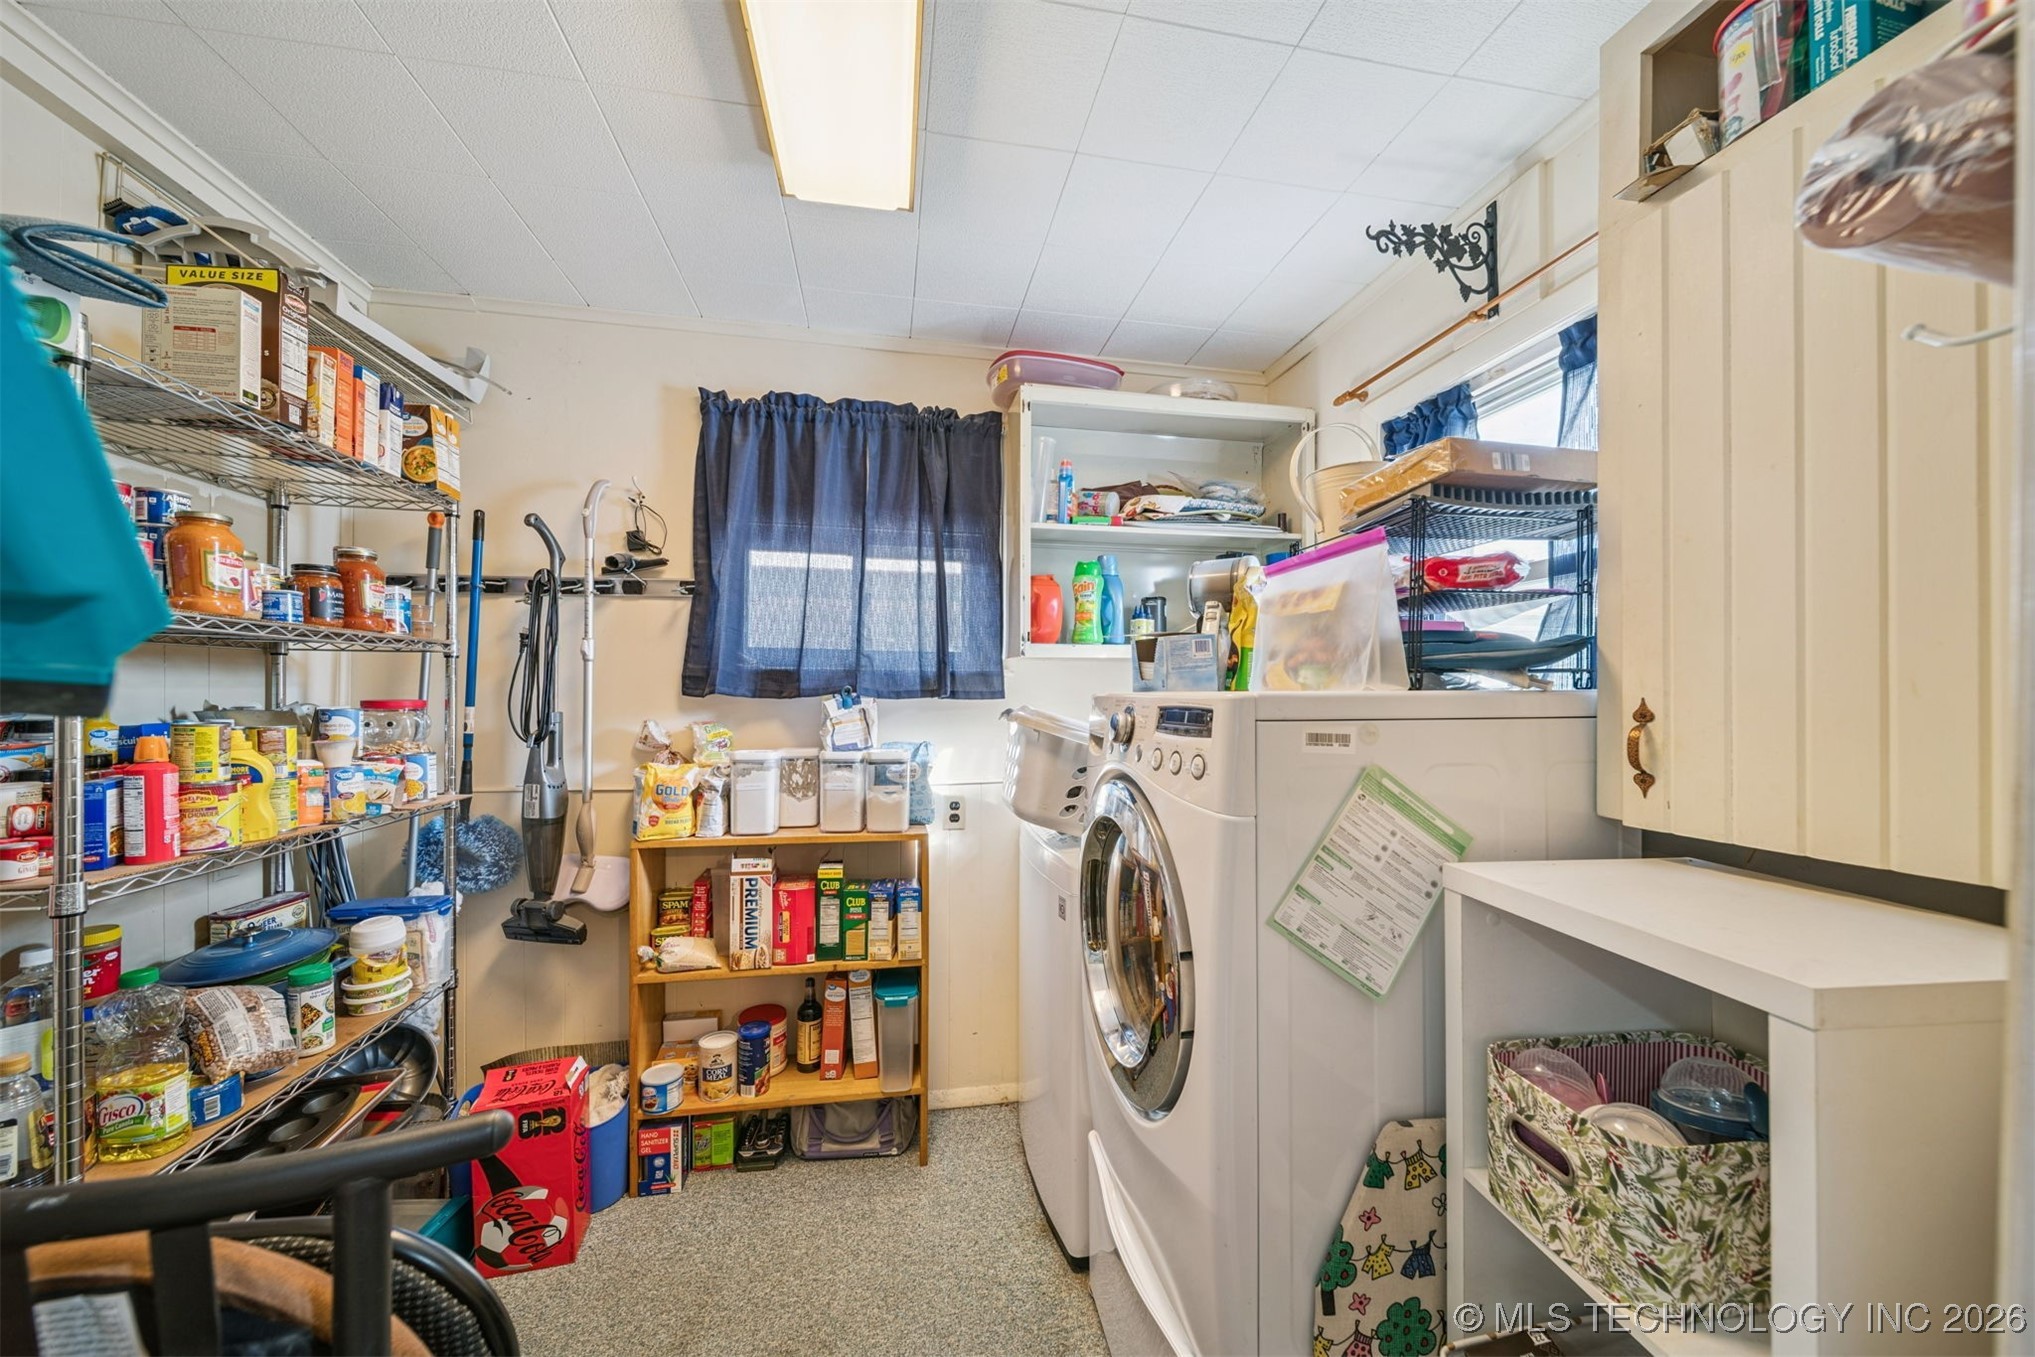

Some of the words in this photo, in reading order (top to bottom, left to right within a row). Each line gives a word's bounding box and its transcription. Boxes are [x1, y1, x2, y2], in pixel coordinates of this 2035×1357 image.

[179, 269, 226, 280] VALUE
[231, 271, 264, 281] SIZE
[1072, 580, 1095, 596] Gain
[656, 784, 689, 796] GOLD
[820, 880, 840, 890] CLUB
[662, 900, 689, 910] SPAM
[846, 897, 866, 907] CLUB
[744, 877, 758, 950] PREMIUM
[706, 1066, 728, 1076] CORN
[706, 1073, 728, 1081] MEAL
[99, 1103, 136, 1127] Crisco
[640, 1138, 669, 1147] SANITIZER
[482, 1191, 561, 1264] Coca-Cola
